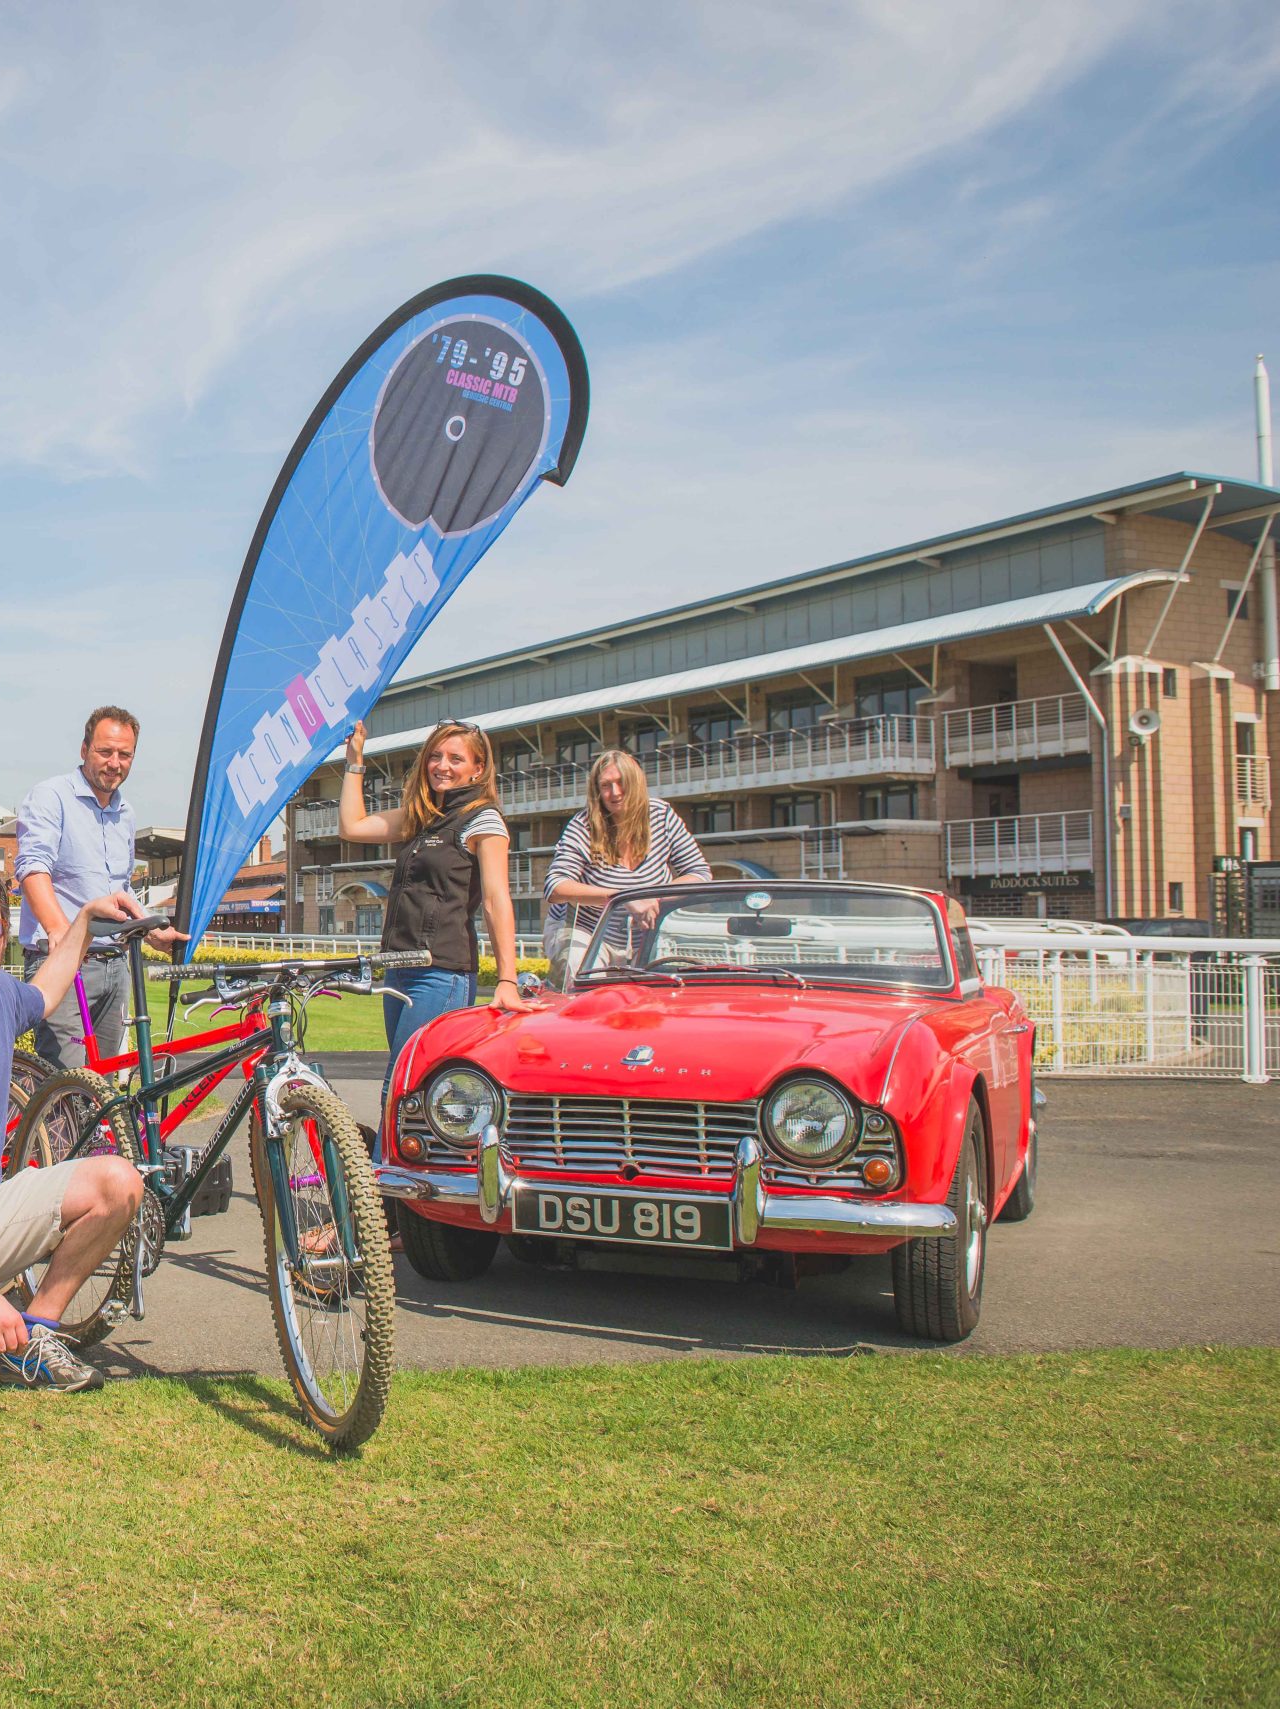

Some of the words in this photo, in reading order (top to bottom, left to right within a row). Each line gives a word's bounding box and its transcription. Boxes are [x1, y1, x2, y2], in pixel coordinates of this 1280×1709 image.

[446, 368, 493, 396] CLASSIC
[492, 381, 519, 403] MTB
[990, 877, 1040, 889] PADDOCK
[1040, 875, 1080, 887] SUITES
[559, 1062, 712, 1076] TRIUMPH
[538, 1193, 620, 1234] DSU
[632, 1202, 701, 1241] 819
